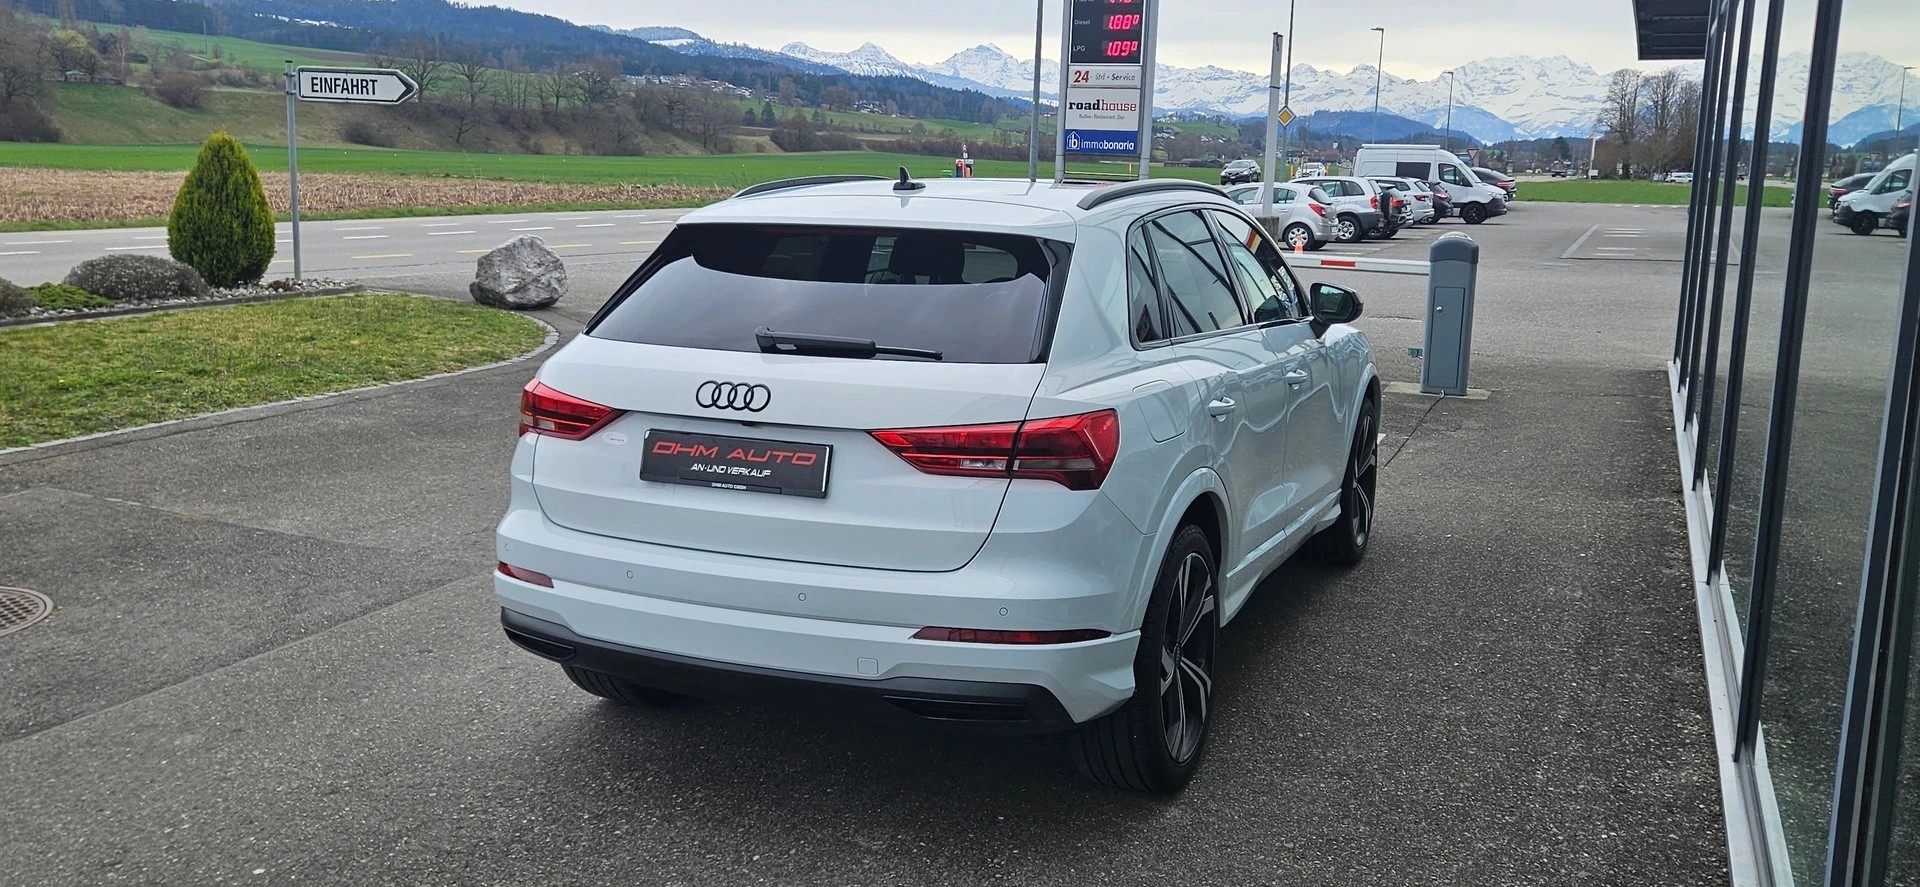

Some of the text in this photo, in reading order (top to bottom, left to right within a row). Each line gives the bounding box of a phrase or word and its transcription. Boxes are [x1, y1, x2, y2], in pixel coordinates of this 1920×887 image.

[1073, 70, 1090, 83] 24
[1111, 72, 1136, 81] Service
[310, 76, 378, 95] EINFAHRT
[1068, 99, 1137, 111] roadhouse
[1080, 139, 1135, 150] immobonaria
[726, 448, 817, 466] AUTO
[727, 466, 772, 478] VERKAUF
